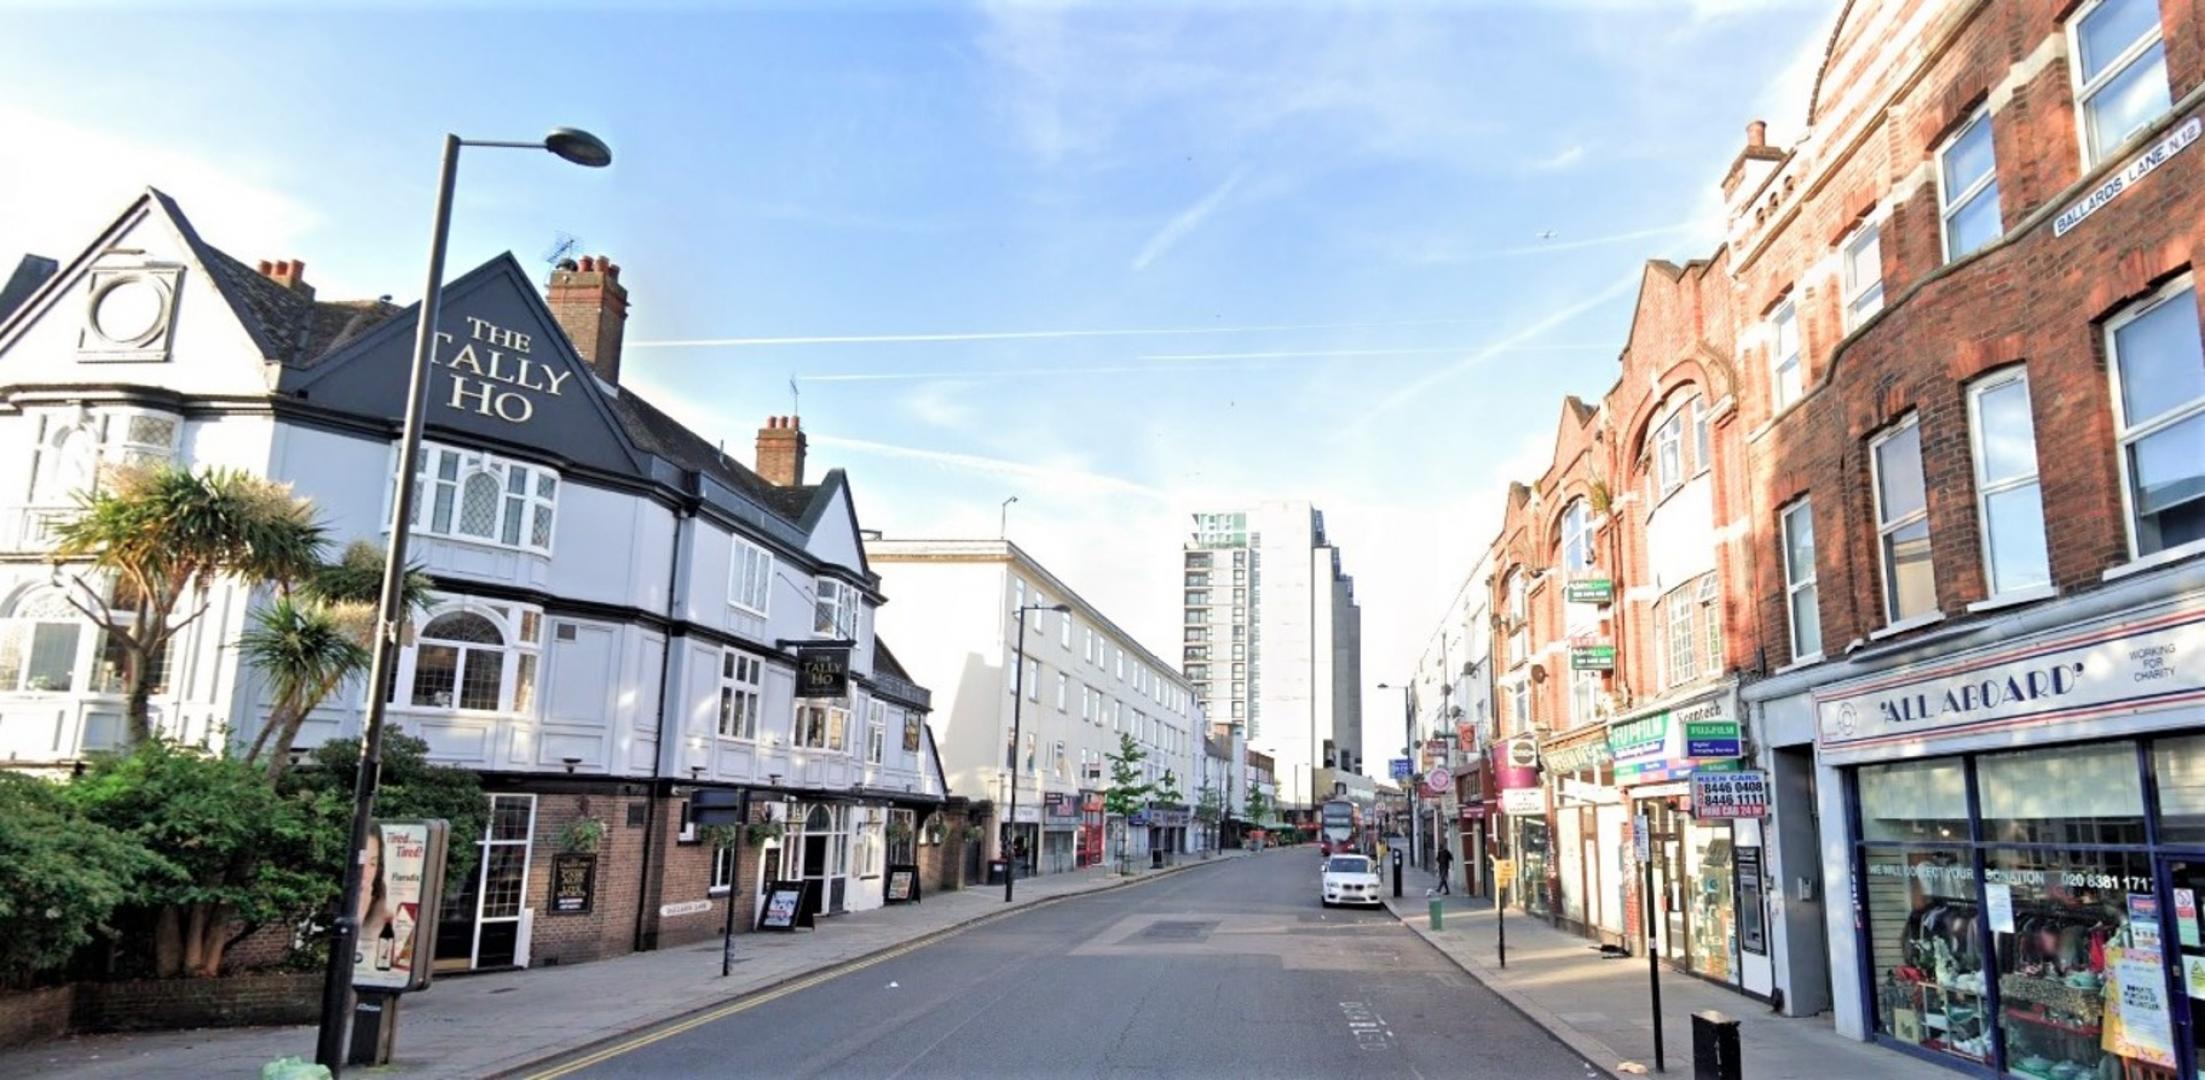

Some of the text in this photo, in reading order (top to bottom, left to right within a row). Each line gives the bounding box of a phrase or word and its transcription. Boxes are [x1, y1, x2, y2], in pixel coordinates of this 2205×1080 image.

[2056, 177, 2123, 233] BALLARDS
[466, 316, 532, 353] THE
[431, 332, 572, 396] TALLY
[446, 374, 533, 423] HO
[2129, 644, 2176, 660] WORKING
[804, 662, 842, 673] TALLY
[2143, 657, 2164, 669] FOR
[811, 673, 833, 685] HO
[2134, 666, 2176, 682] CHARITY
[1690, 725, 1735, 735] FUJIFILM
[1704, 781, 1763, 793] 8446 0408
[1704, 793, 1764, 806] 8446 1111
[1740, 806, 1752, 816] 24
[1946, 866, 1975, 880] YOUR
[1985, 868, 2044, 884] DONATION
[2061, 871, 2084, 887] 020
[2087, 874, 2119, 890] 8381
